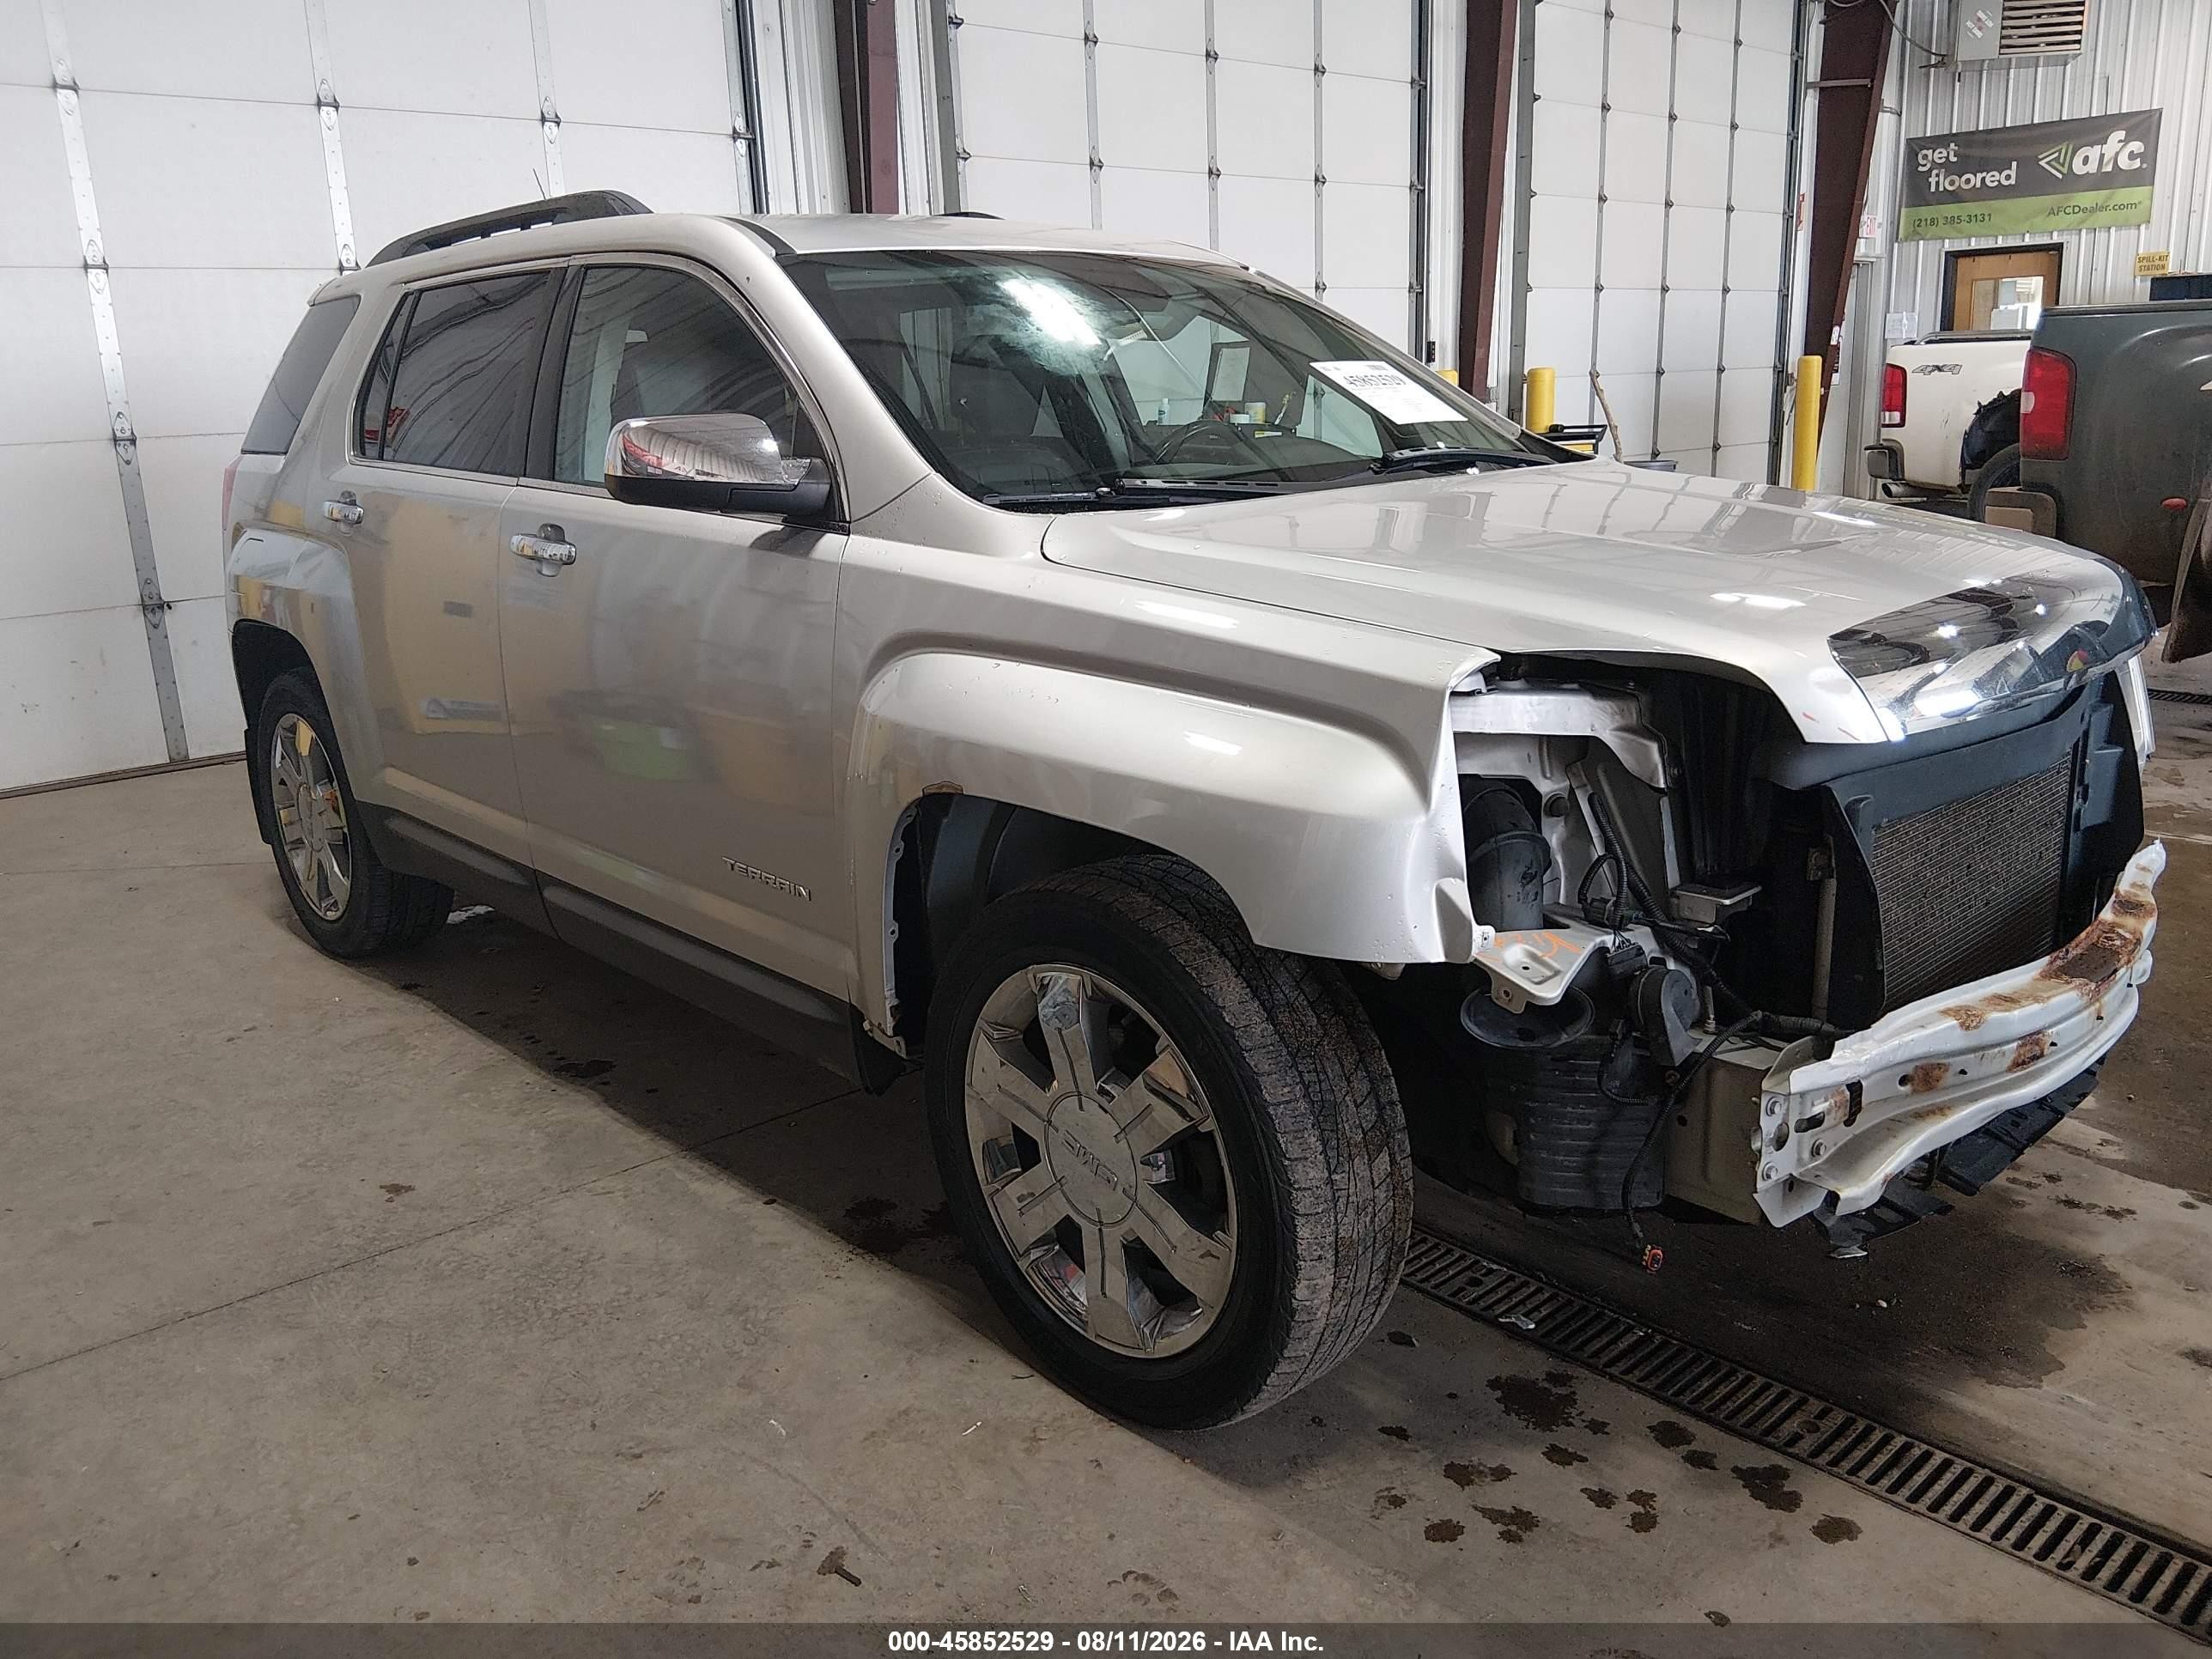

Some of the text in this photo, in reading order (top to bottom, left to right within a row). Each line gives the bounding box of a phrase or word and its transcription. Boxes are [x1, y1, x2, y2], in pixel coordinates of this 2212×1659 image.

[1917, 143, 1959, 172] get
[1929, 161, 2017, 192] floored
[1912, 213, 1992, 229] (218) 385-3131
[2137, 253, 2169, 264] SPILL-KIT
[2138, 263, 2166, 272] STATION
[721, 855, 811, 902] TERRAIN
[1061, 1129, 1118, 1191] GMC
